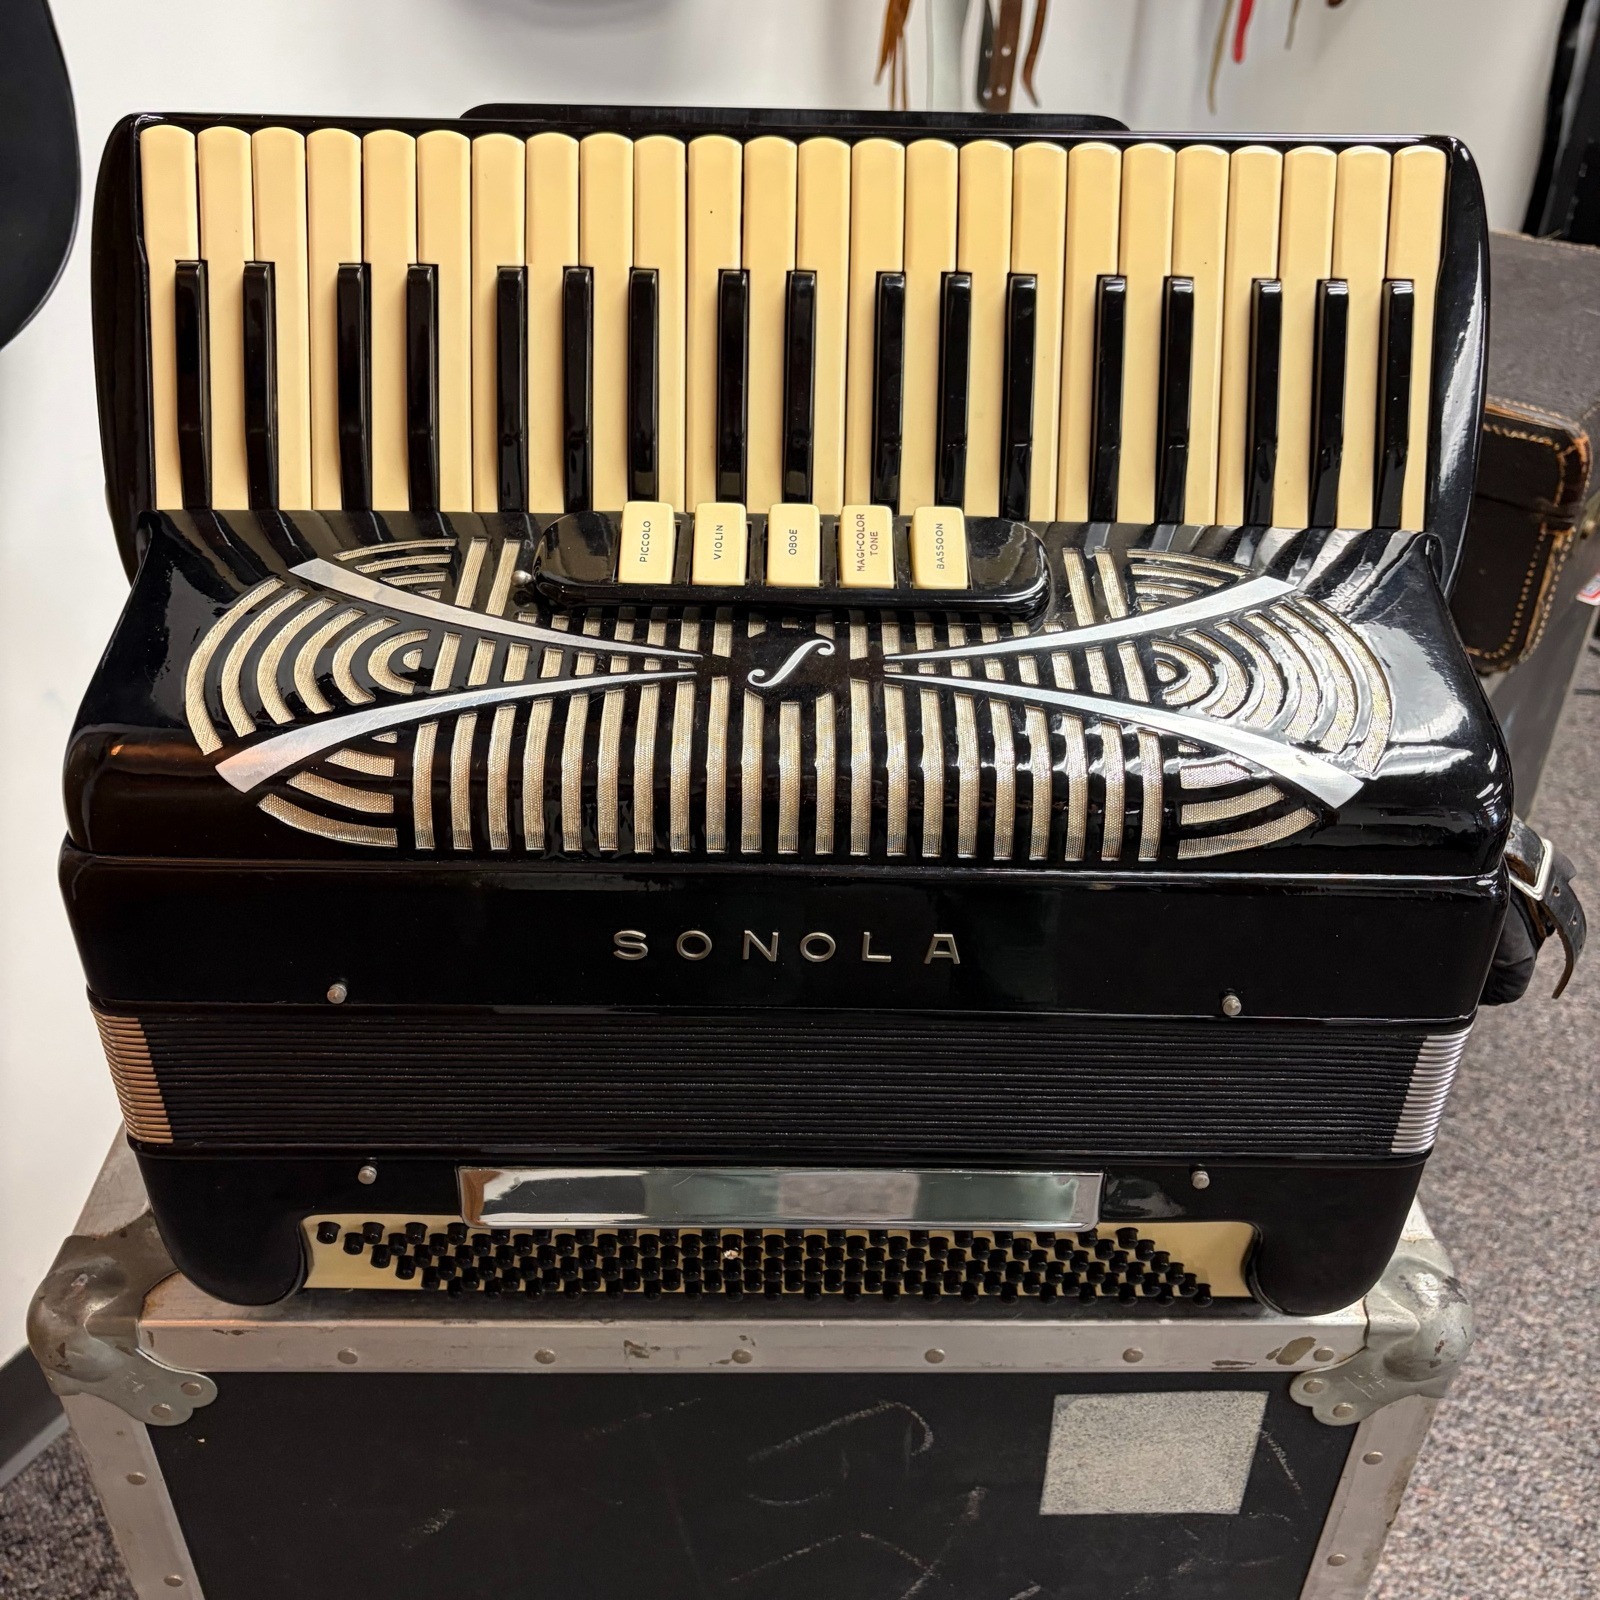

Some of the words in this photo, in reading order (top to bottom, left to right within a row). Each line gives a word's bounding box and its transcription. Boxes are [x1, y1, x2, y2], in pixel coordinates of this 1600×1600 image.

[639, 520, 652, 563] PICCOLO
[713, 524, 724, 560] VIOLIN
[788, 528, 798, 556] OBOE
[870, 531, 879, 557] TONE
[935, 522, 945, 570] BASSOON
[613, 929, 961, 965] SONOLA
